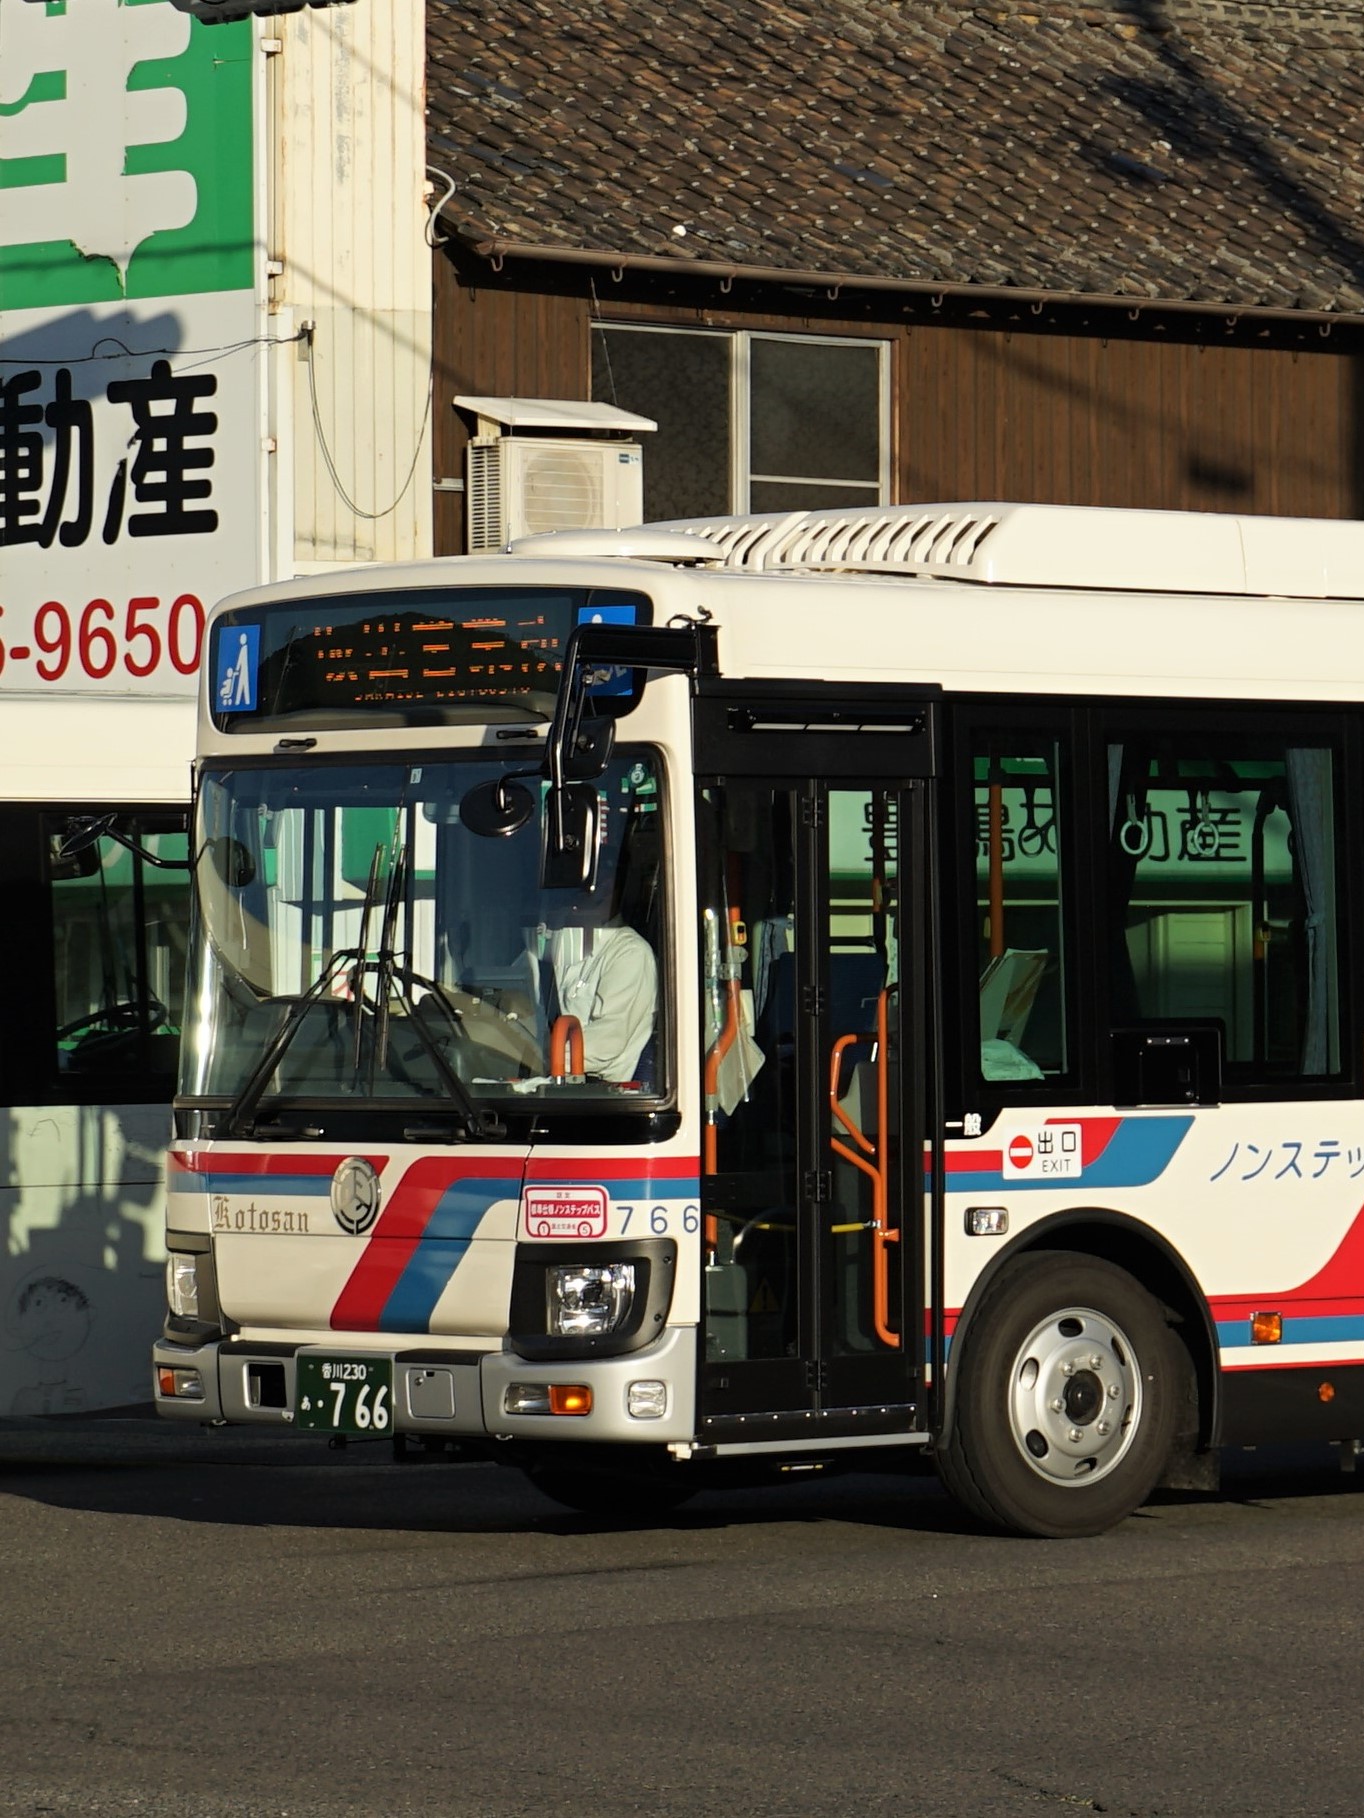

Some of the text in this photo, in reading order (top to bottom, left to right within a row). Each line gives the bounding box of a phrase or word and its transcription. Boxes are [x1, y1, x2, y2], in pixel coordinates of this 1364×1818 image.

[1038, 1131, 1076, 1154] 出口
[1042, 1159, 1071, 1172] EXIT
[214, 1195, 310, 1232] Kotosan
[616, 1205, 699, 1235] 766
